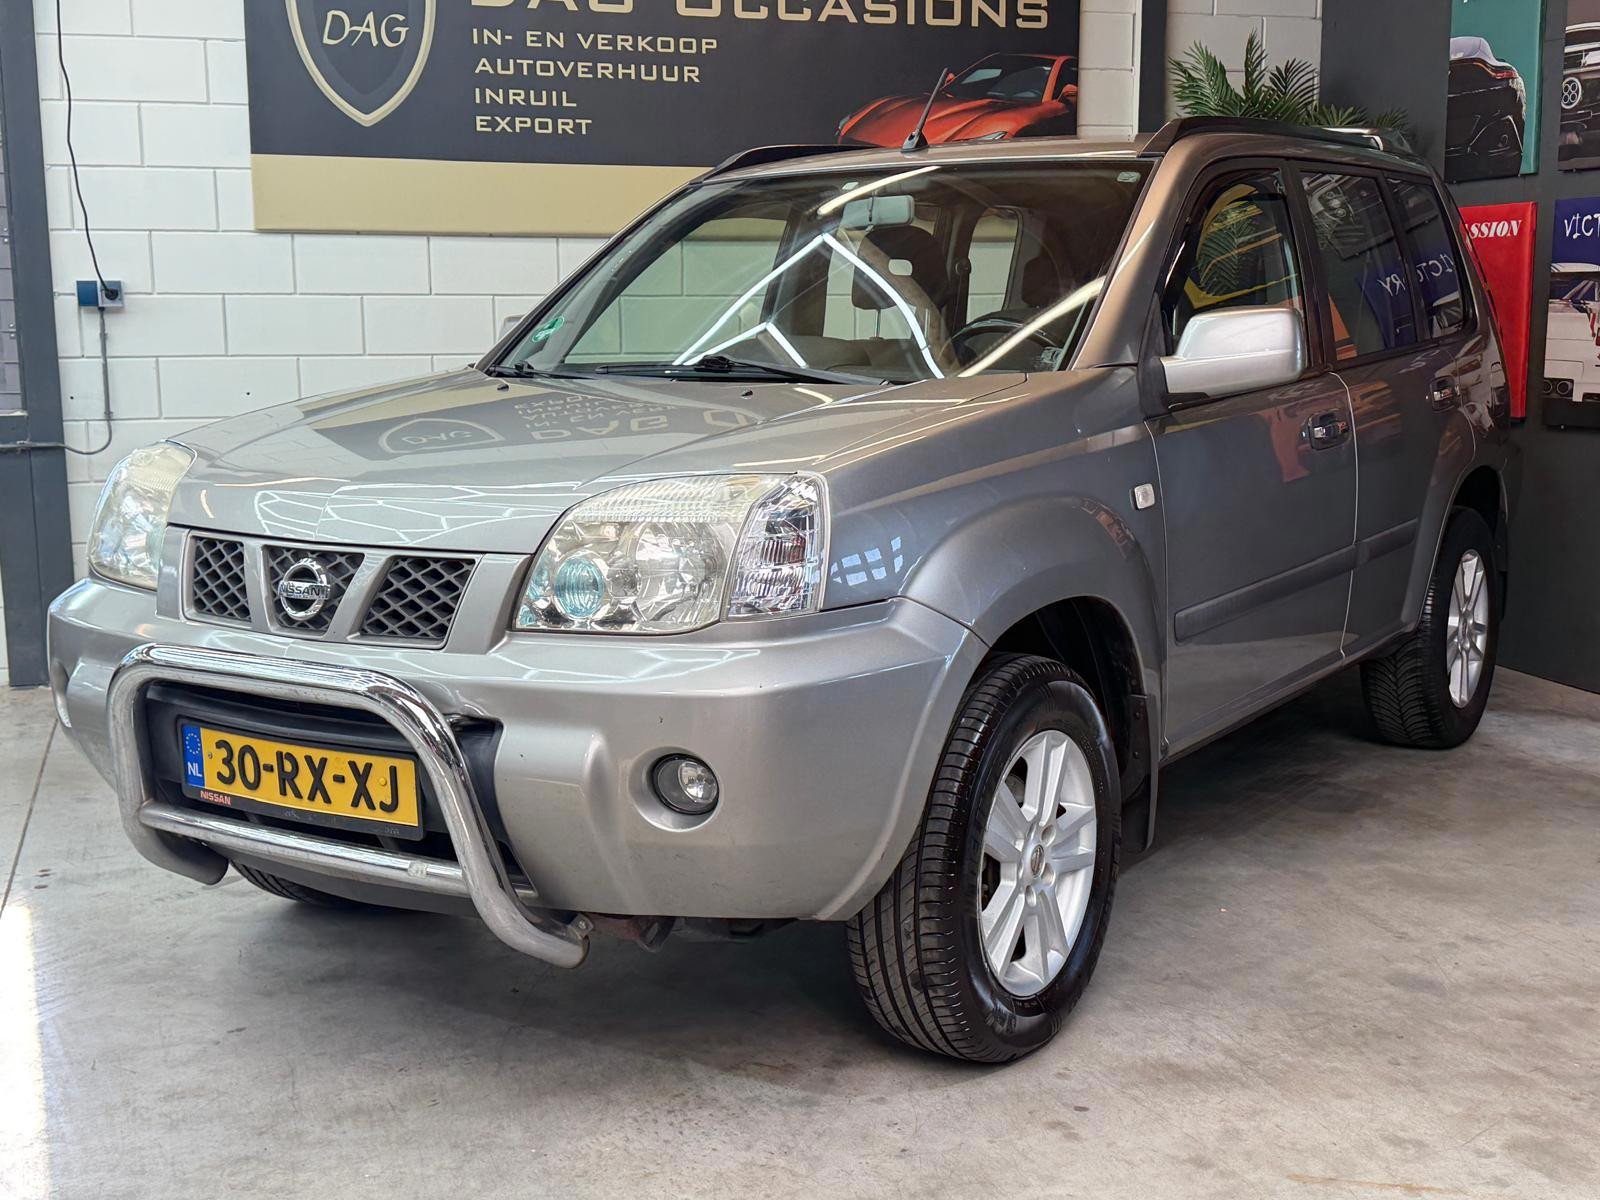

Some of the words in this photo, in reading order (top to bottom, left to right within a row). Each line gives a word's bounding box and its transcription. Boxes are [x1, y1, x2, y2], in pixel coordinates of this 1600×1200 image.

[322, 9, 410, 48] DAG
[472, 28, 513, 46] IN-
[526, 30, 565, 48] EN
[576, 33, 718, 55] VERKOOP
[474, 57, 700, 83] AUTOVERHUUR
[475, 87, 577, 107] INRUIL
[475, 115, 593, 135] EXPORT
[1465, 219, 1522, 240] SSION
[280, 581, 321, 597] NISSAN
[187, 761, 203, 778] NL
[215, 739, 399, 813] 30-RX-XJ
[200, 790, 232, 806] NISSAN
